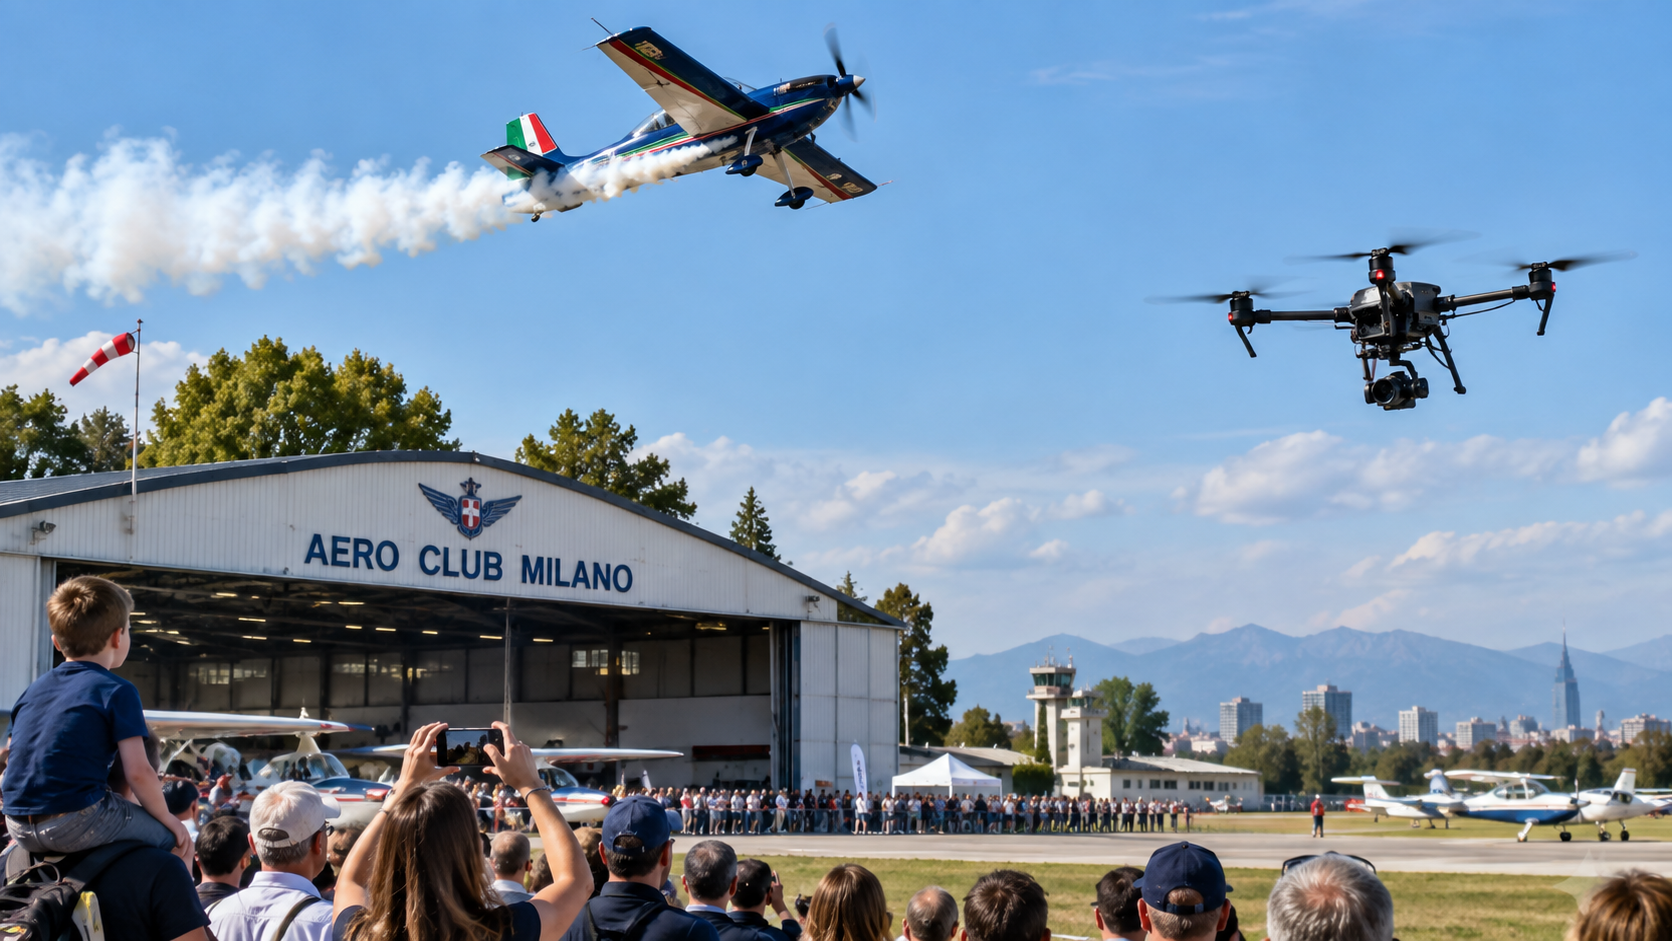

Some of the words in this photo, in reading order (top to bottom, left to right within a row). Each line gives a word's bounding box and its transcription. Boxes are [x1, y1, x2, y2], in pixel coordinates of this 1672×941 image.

[304, 533, 400, 572] AERO
[419, 545, 503, 581] CLUB
[521, 554, 634, 593] MILANO
